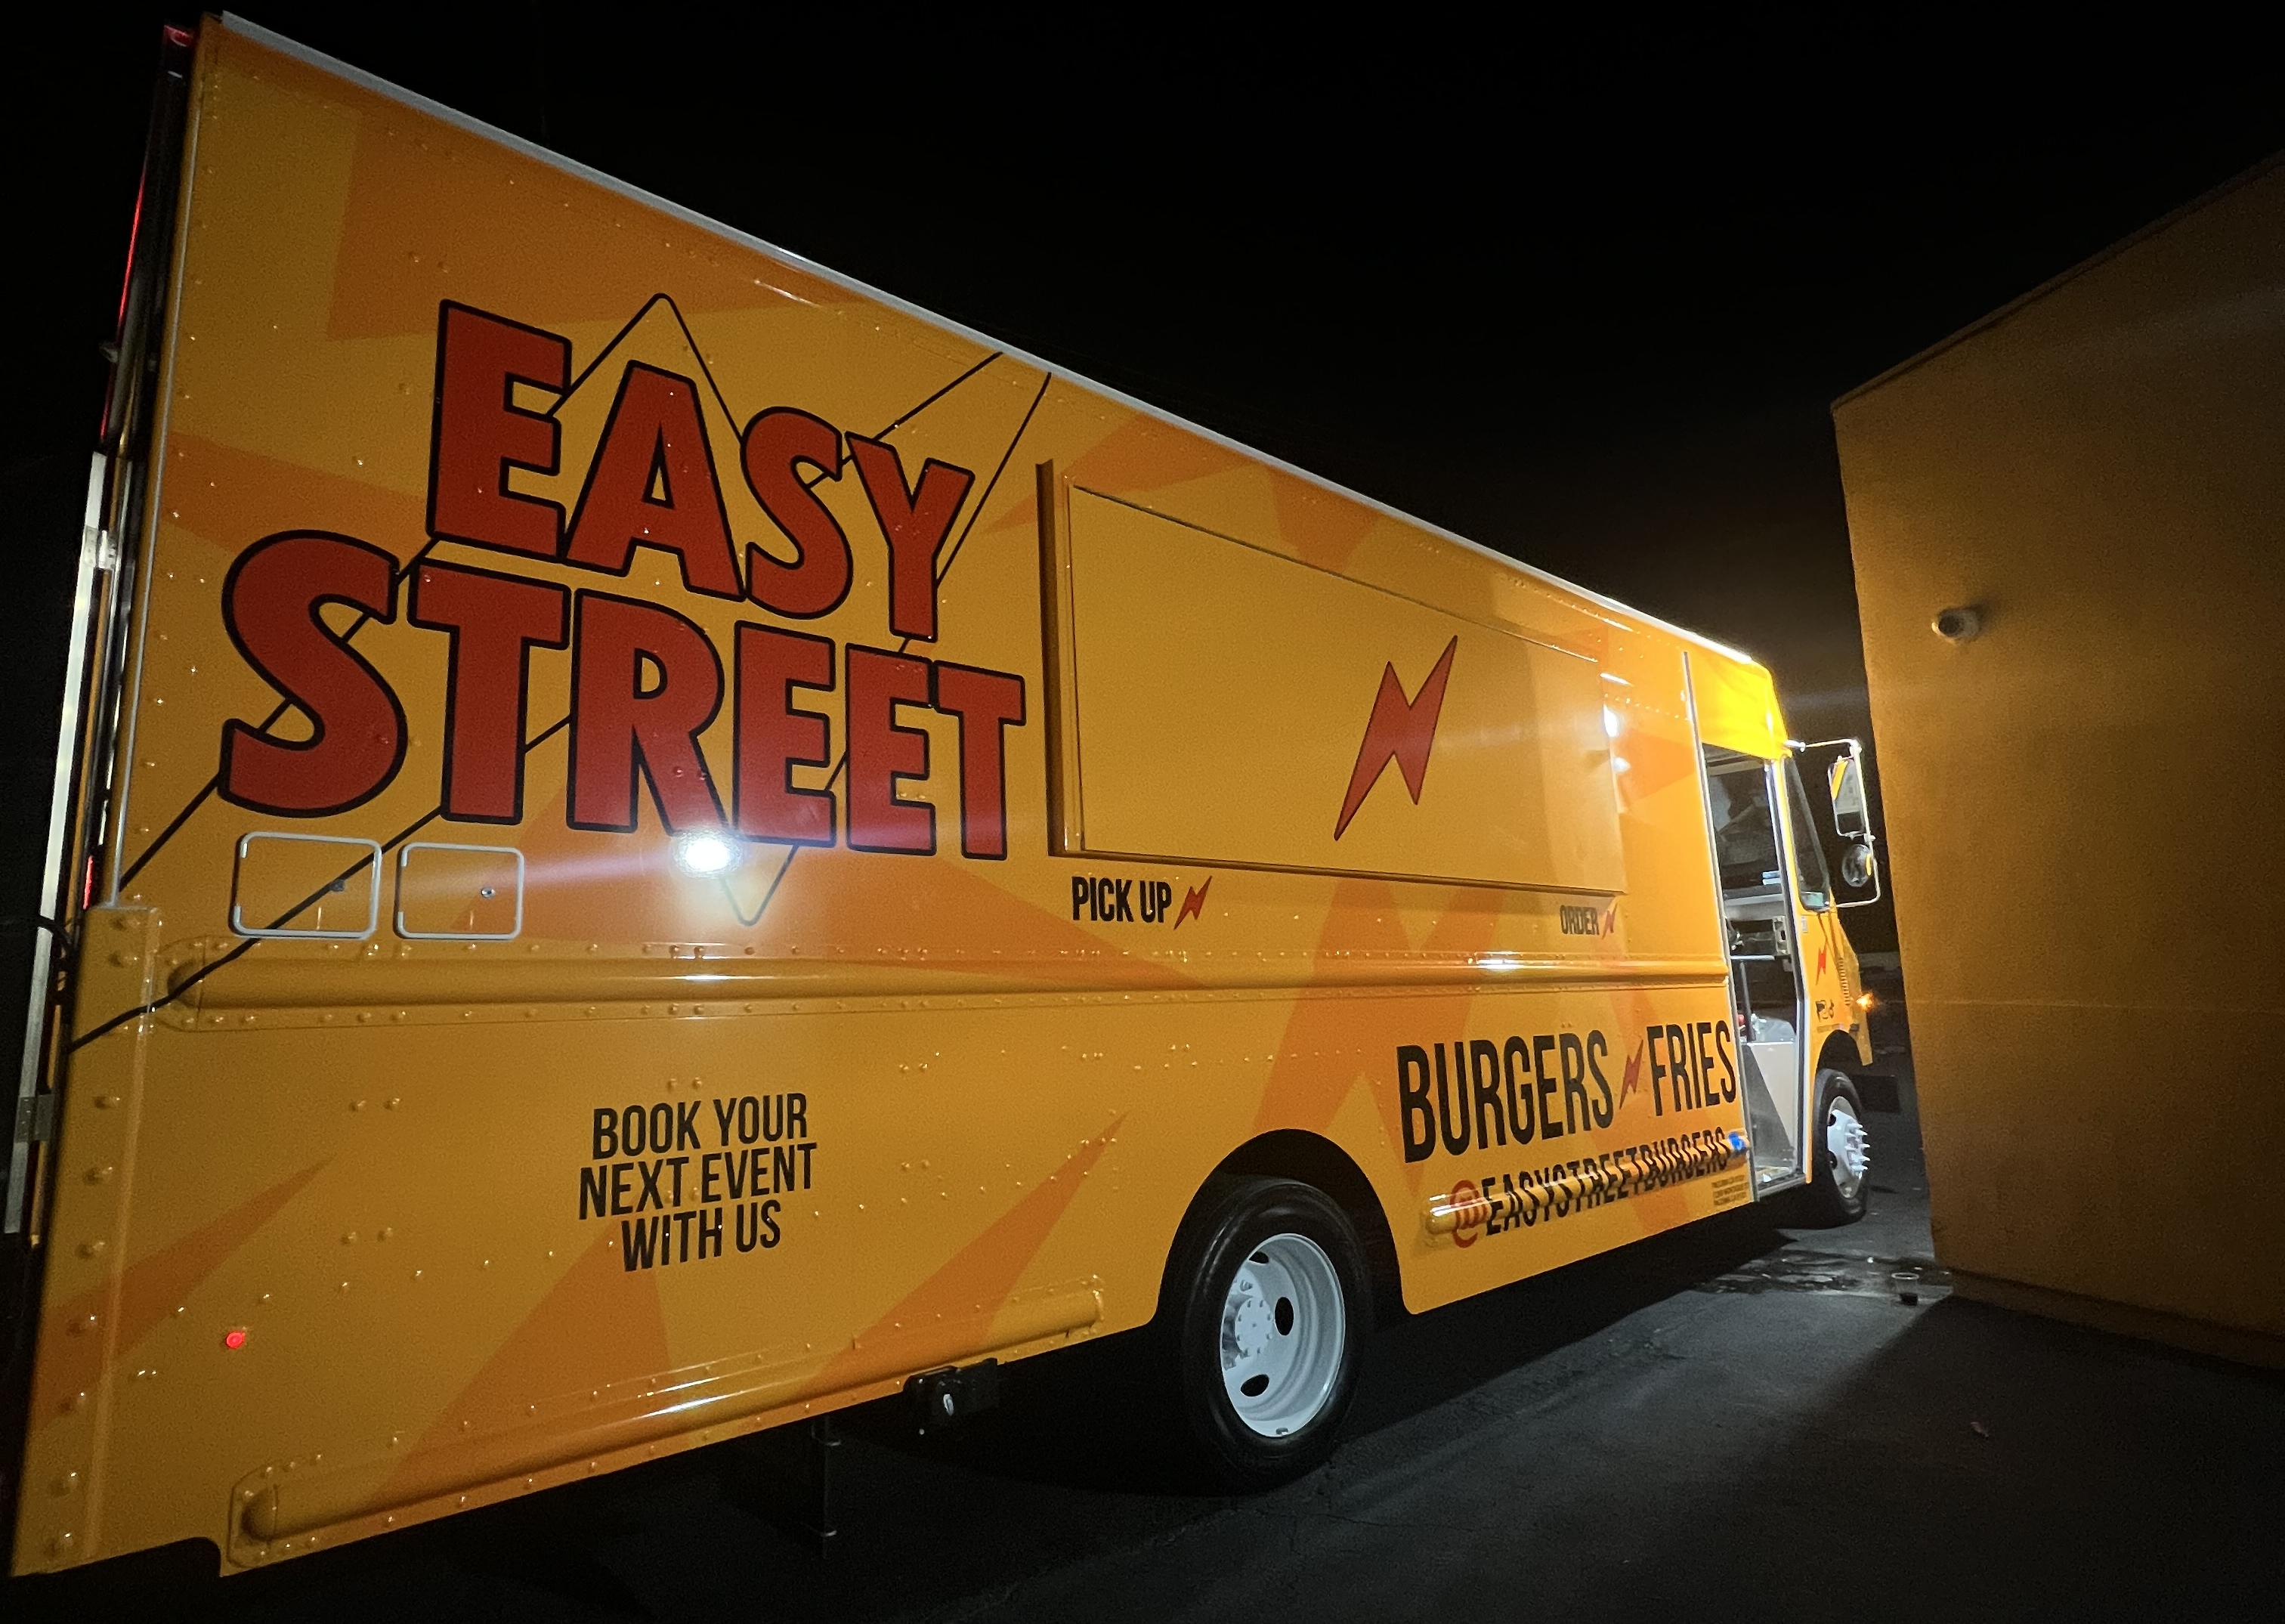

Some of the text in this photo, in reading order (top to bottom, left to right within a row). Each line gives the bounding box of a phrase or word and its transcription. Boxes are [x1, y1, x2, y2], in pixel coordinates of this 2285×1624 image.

[426, 299, 975, 642] EASY
[220, 531, 1026, 859] STREET
[1071, 876, 1172, 923] PICK UP
[1560, 905, 1600, 936] ORDER
[592, 1093, 808, 1160] BOOK YOUR
[1396, 1020, 1736, 1163] BURGERS FRIES
[579, 1142, 817, 1220] NEXT EVENT
[621, 1199, 781, 1272] WITH US
